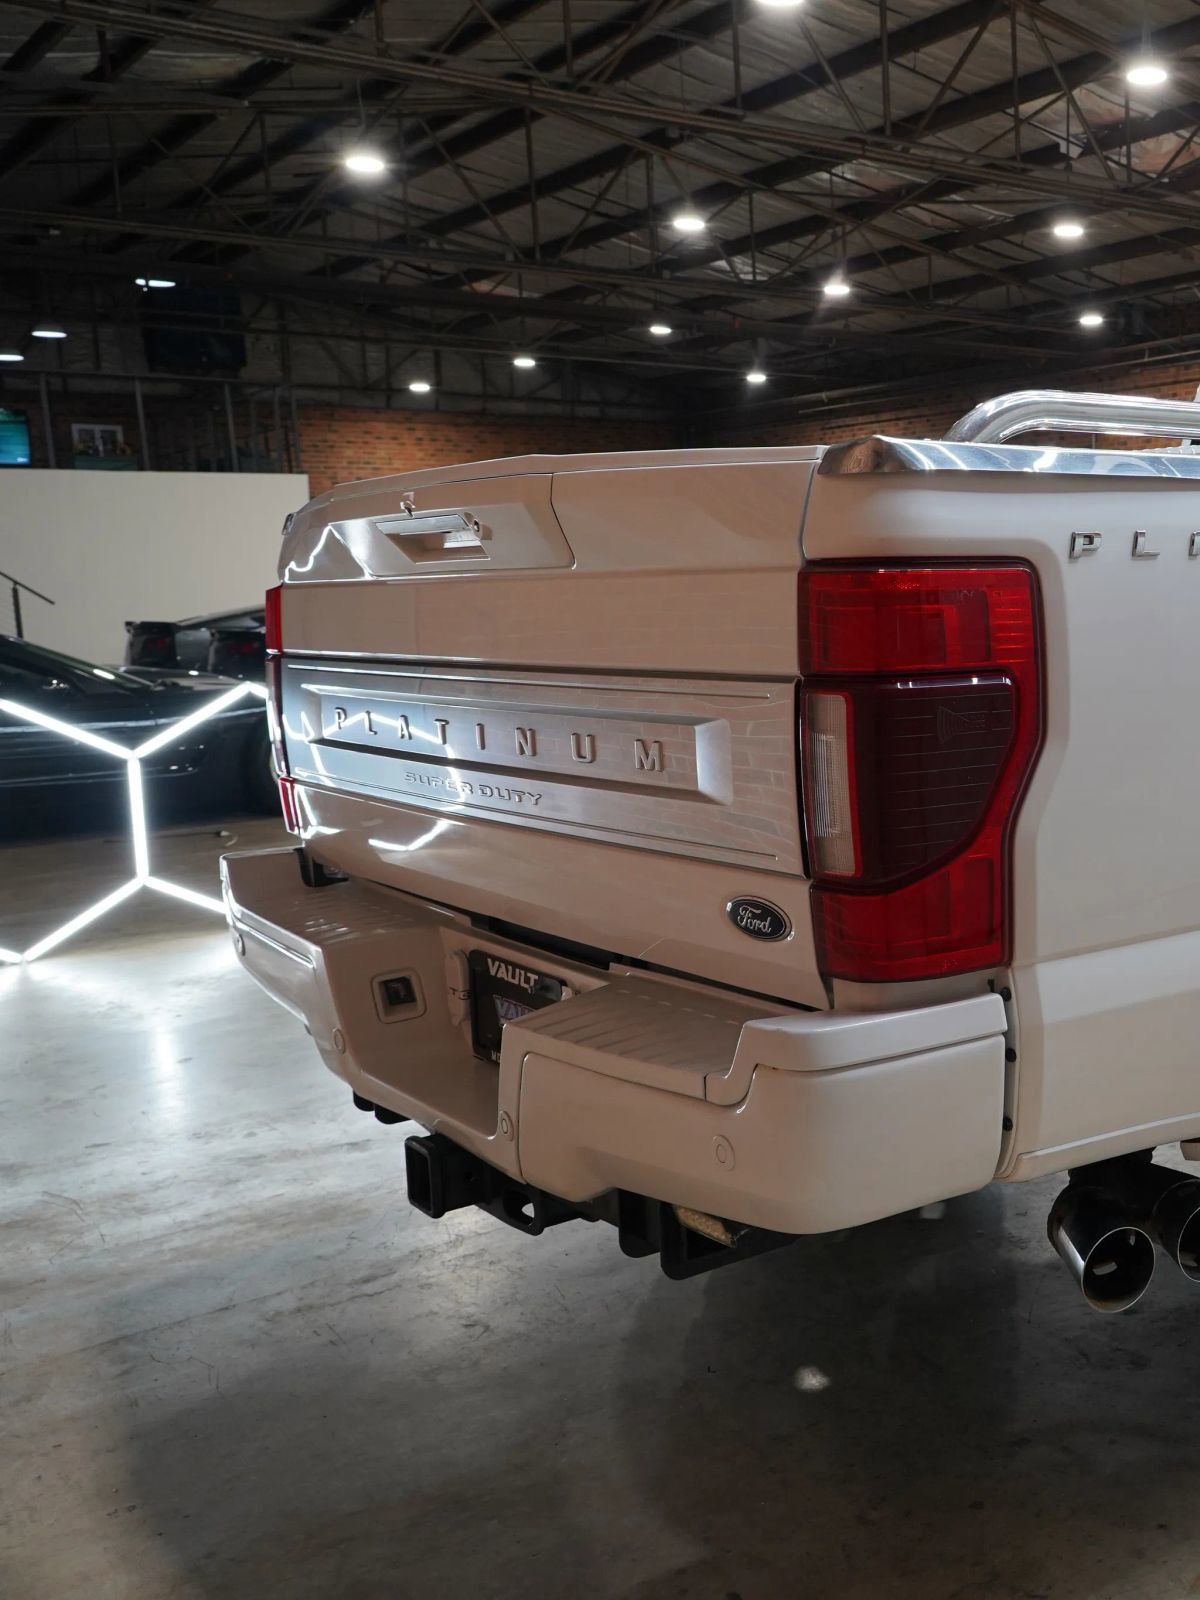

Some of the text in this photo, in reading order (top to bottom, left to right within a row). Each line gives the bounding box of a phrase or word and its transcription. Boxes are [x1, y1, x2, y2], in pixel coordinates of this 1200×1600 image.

[333, 706, 664, 772] PLATINUM
[404, 771, 543, 806] SUPER DUTY
[737, 905, 772, 933] Ford
[487, 958, 539, 989] VAULT
